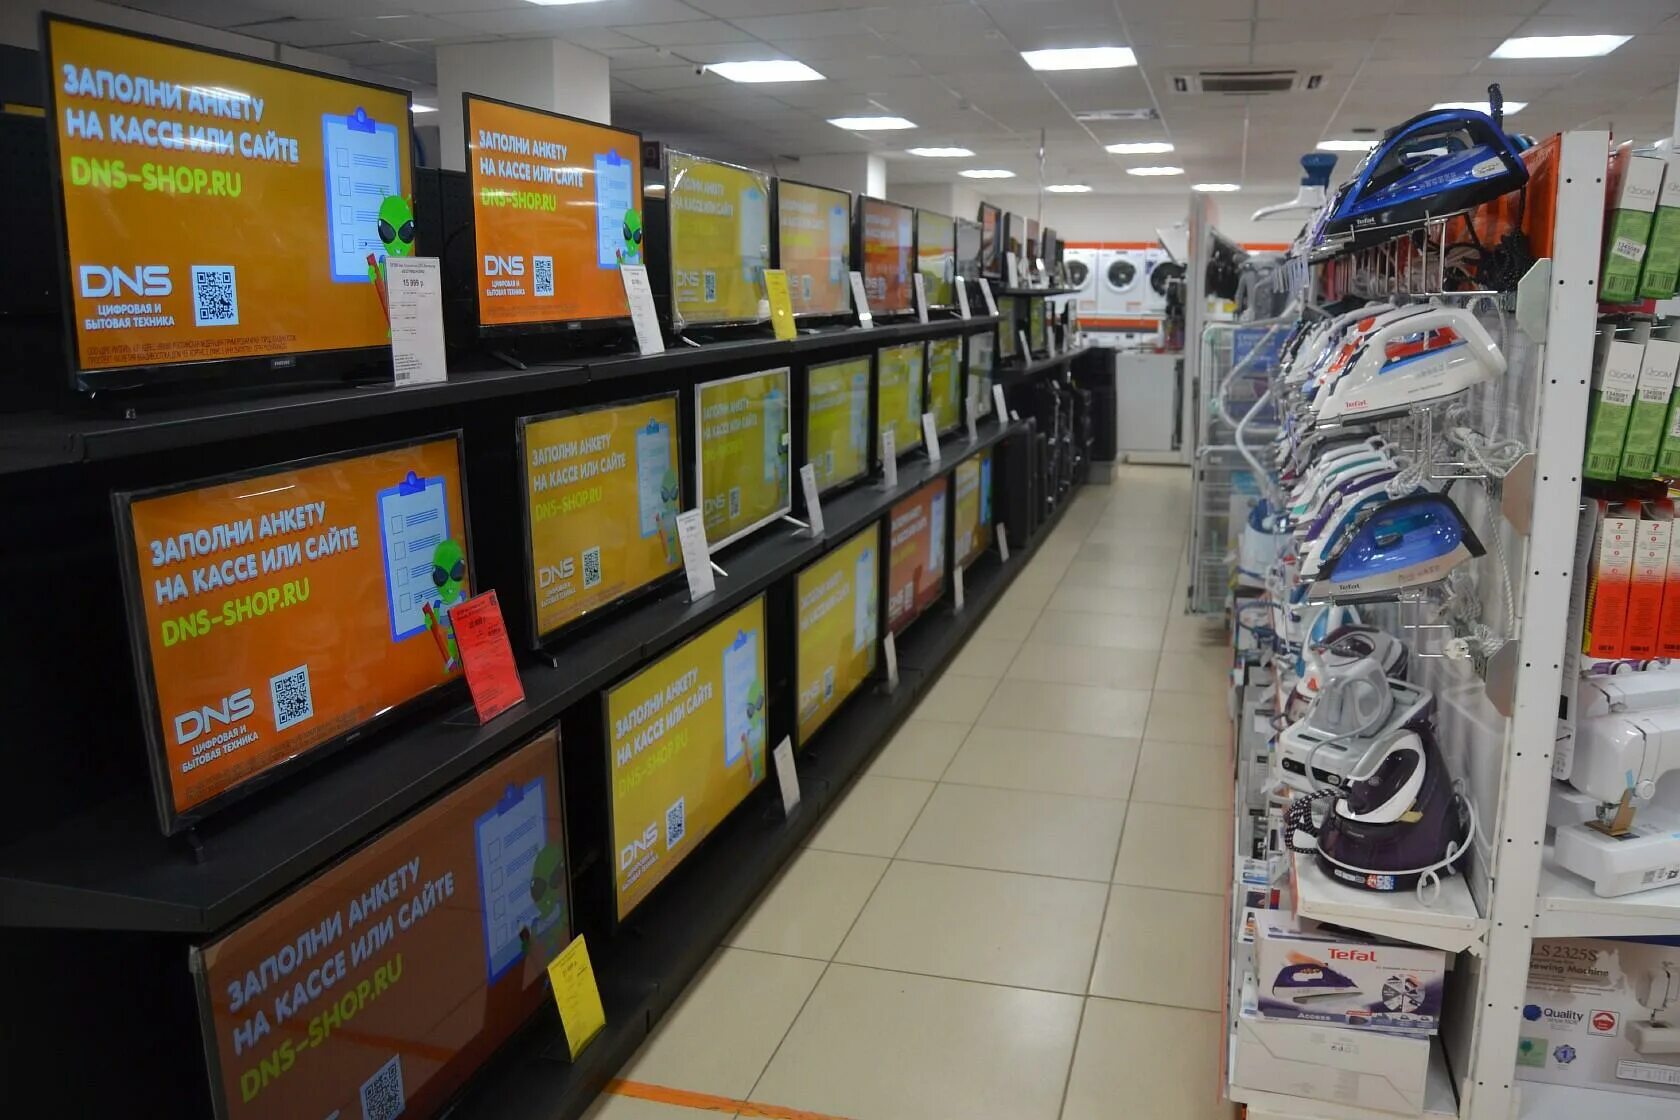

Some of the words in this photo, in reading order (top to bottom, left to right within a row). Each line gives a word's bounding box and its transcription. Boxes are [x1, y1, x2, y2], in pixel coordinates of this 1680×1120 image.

[63, 64, 182, 112] ЗАПОЛНИ
[189, 86, 264, 122] АНКЕТУ
[66, 108, 103, 140] НА
[110, 113, 184, 149] КАССЕ
[190, 124, 234, 155] ИЛИ
[240, 131, 299, 163] САЙТЕ
[479, 130, 530, 155] ЗАПОЛНИ
[532, 140, 567, 160] АНКЕТУ
[70, 156, 242, 197] DNS-SHOP.RU
[480, 157, 496, 176] НА
[498, 160, 530, 181] КАССЕ
[533, 165, 553, 183] ИЛИ
[556, 168, 583, 188] САЙТЕ
[481, 187, 556, 212] DNS-SHOP.RU
[80, 265, 172, 297] DNS
[484, 255, 525, 276] DNS
[85, 317, 132, 330] БЫТОВАЯ
[134, 316, 175, 328] ТЕХНИКА
[98, 304, 151, 317] ЦИФРОВАЯ
[155, 304, 161, 313] И
[532, 441, 577, 466] ЗАПОЛНИ
[580, 432, 611, 454] АНКЕТУ
[533, 474, 547, 492] НА
[550, 465, 578, 488] КАССЕ
[580, 461, 599, 479] ИЛИ
[601, 452, 626, 473] САЙТЕ
[535, 486, 602, 522] DNS-SHOP.RU
[150, 518, 254, 567] ЗАПОЛНИ
[259, 501, 326, 539] АНКЕТУ
[155, 574, 189, 605] НА
[192, 553, 258, 594] КАССЕ
[262, 541, 302, 574] ИЛИ
[305, 526, 359, 560] САЙТЕ
[539, 557, 575, 588] DNS
[161, 577, 310, 647] DNS-SHOP.RU
[175, 688, 255, 745] DNS
[616, 690, 663, 740] ЗАПОЛНИ
[666, 667, 698, 704] АНКЕТУ
[191, 727, 239, 756] ЦИФРОВАЯ
[240, 724, 247, 734] И
[617, 743, 631, 768] НА
[634, 717, 664, 754] КАССЕ
[666, 702, 685, 731] ИЛИ
[687, 682, 712, 714] САЙТЕ
[182, 750, 222, 773] БЫТОВАЯ
[223, 732, 259, 754] ТЕХНИКА
[621, 822, 658, 871] DNS
[227, 911, 343, 1013] ЗАПОЛНИ
[349, 856, 420, 928] АНКЕТУ
[233, 1010, 270, 1056] НА
[275, 951, 346, 1024] КАССЕ
[351, 916, 394, 967] ИЛИ
[398, 872, 454, 931] САЙТЕ
[1328, 948, 1377, 962] Tefal
[1567, 965, 1609, 977] Machine
[240, 953, 403, 1104] DNS-SHOP.RU
[1544, 1007, 1584, 1021] Quality
